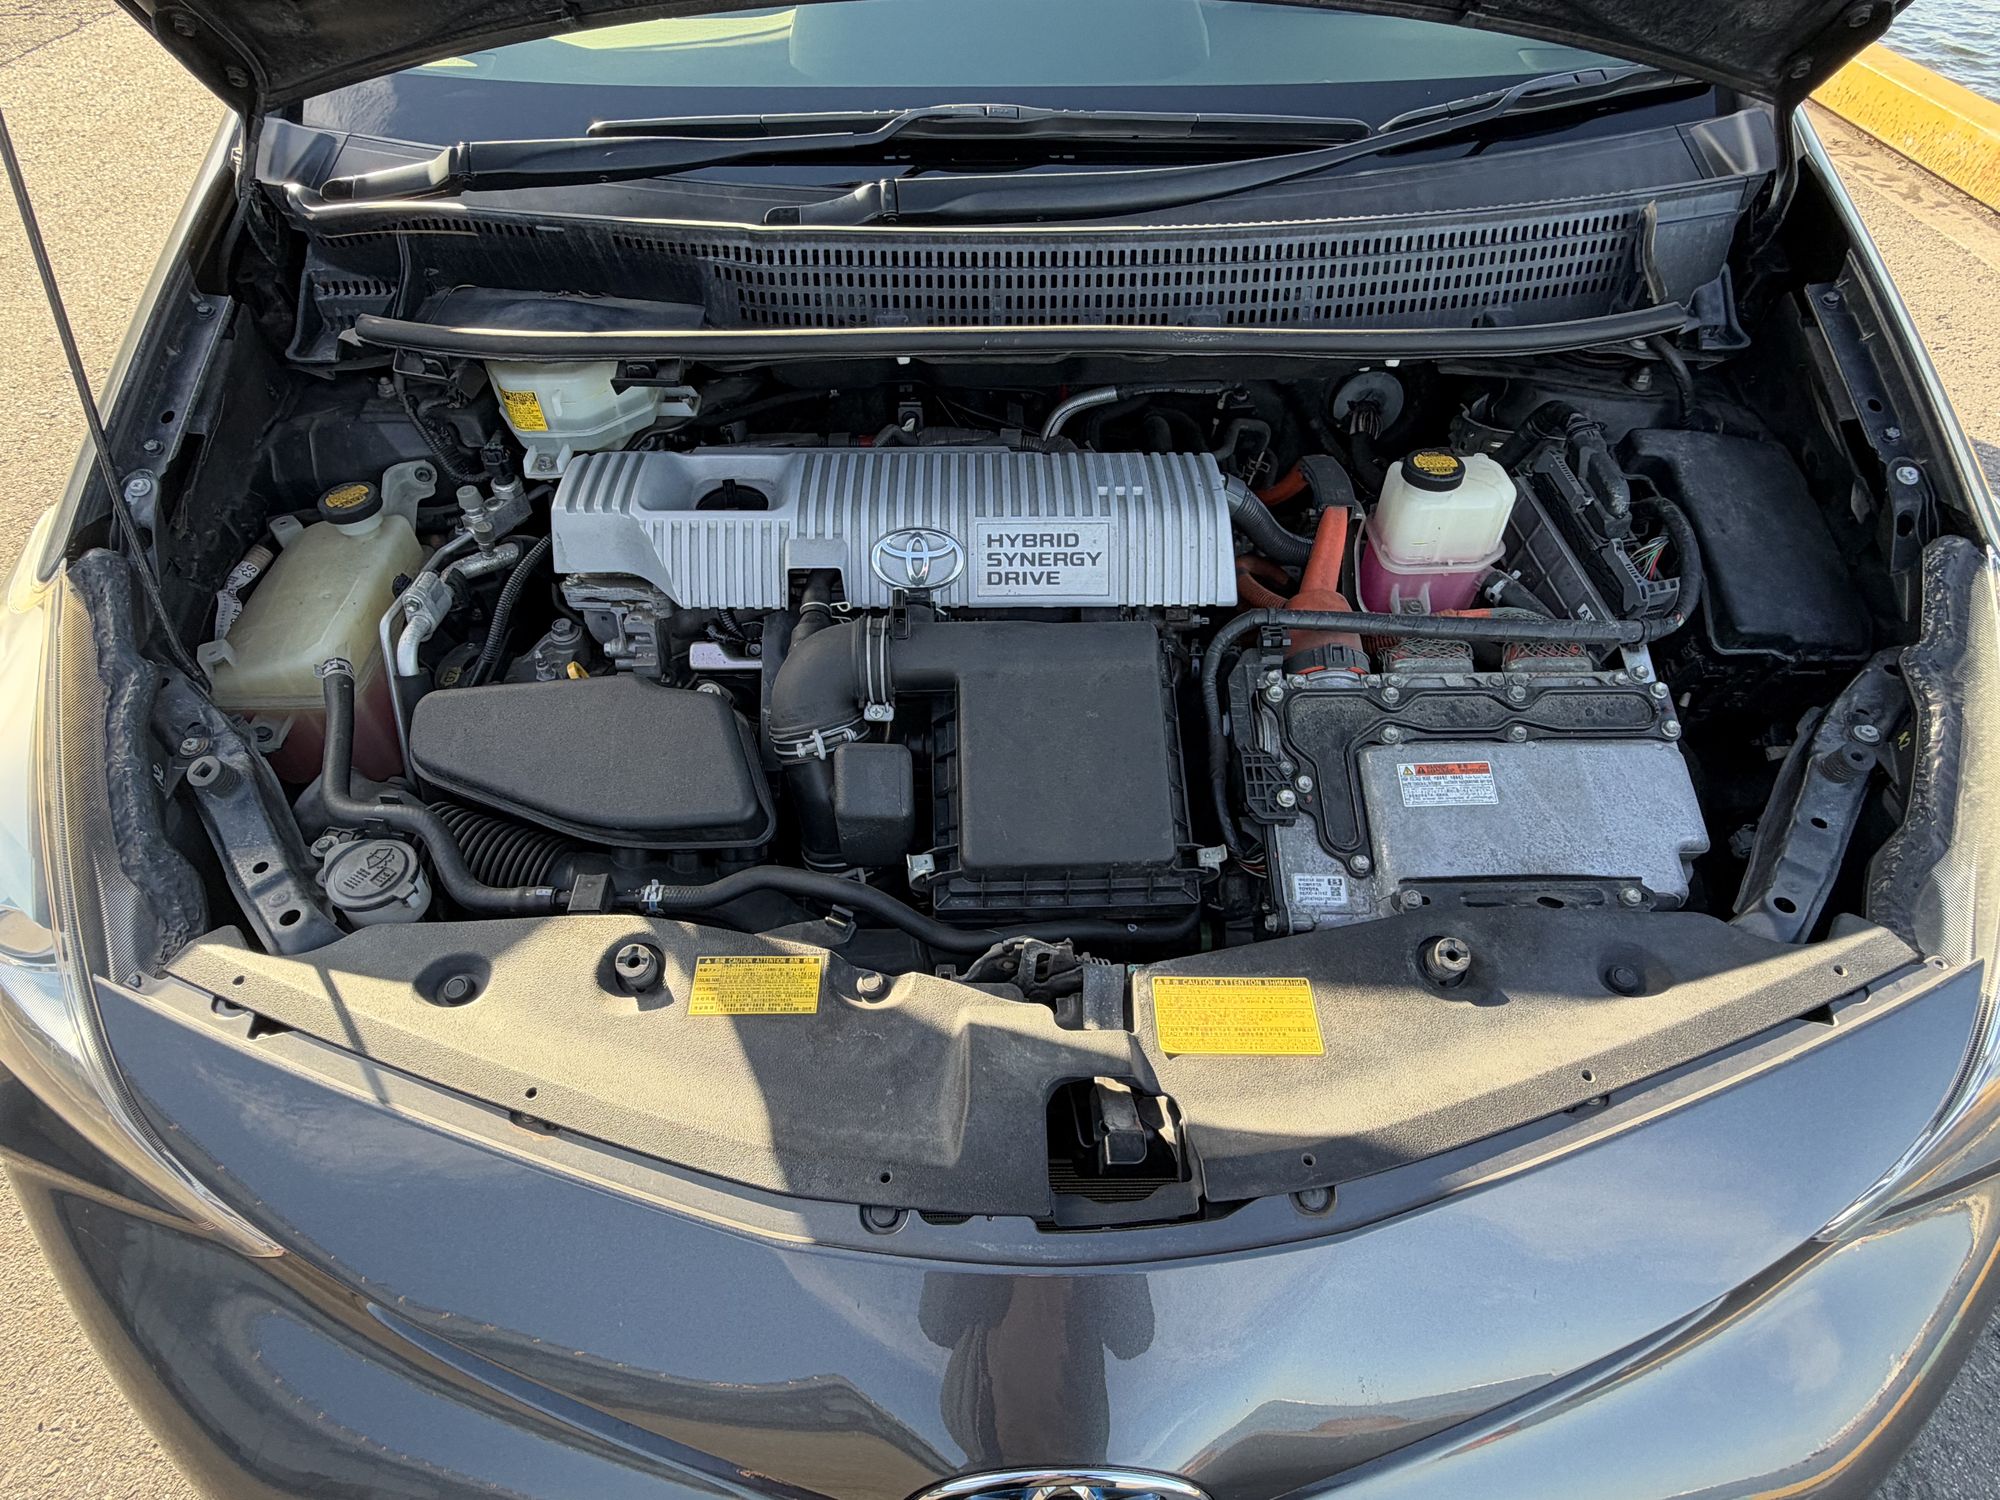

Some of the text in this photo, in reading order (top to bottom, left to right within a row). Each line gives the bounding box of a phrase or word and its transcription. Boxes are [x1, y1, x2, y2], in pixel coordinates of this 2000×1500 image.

[986, 533, 1079, 548] HYBRID
[986, 551, 1102, 567] SYNERGY
[986, 571, 1061, 586] DRIVE
